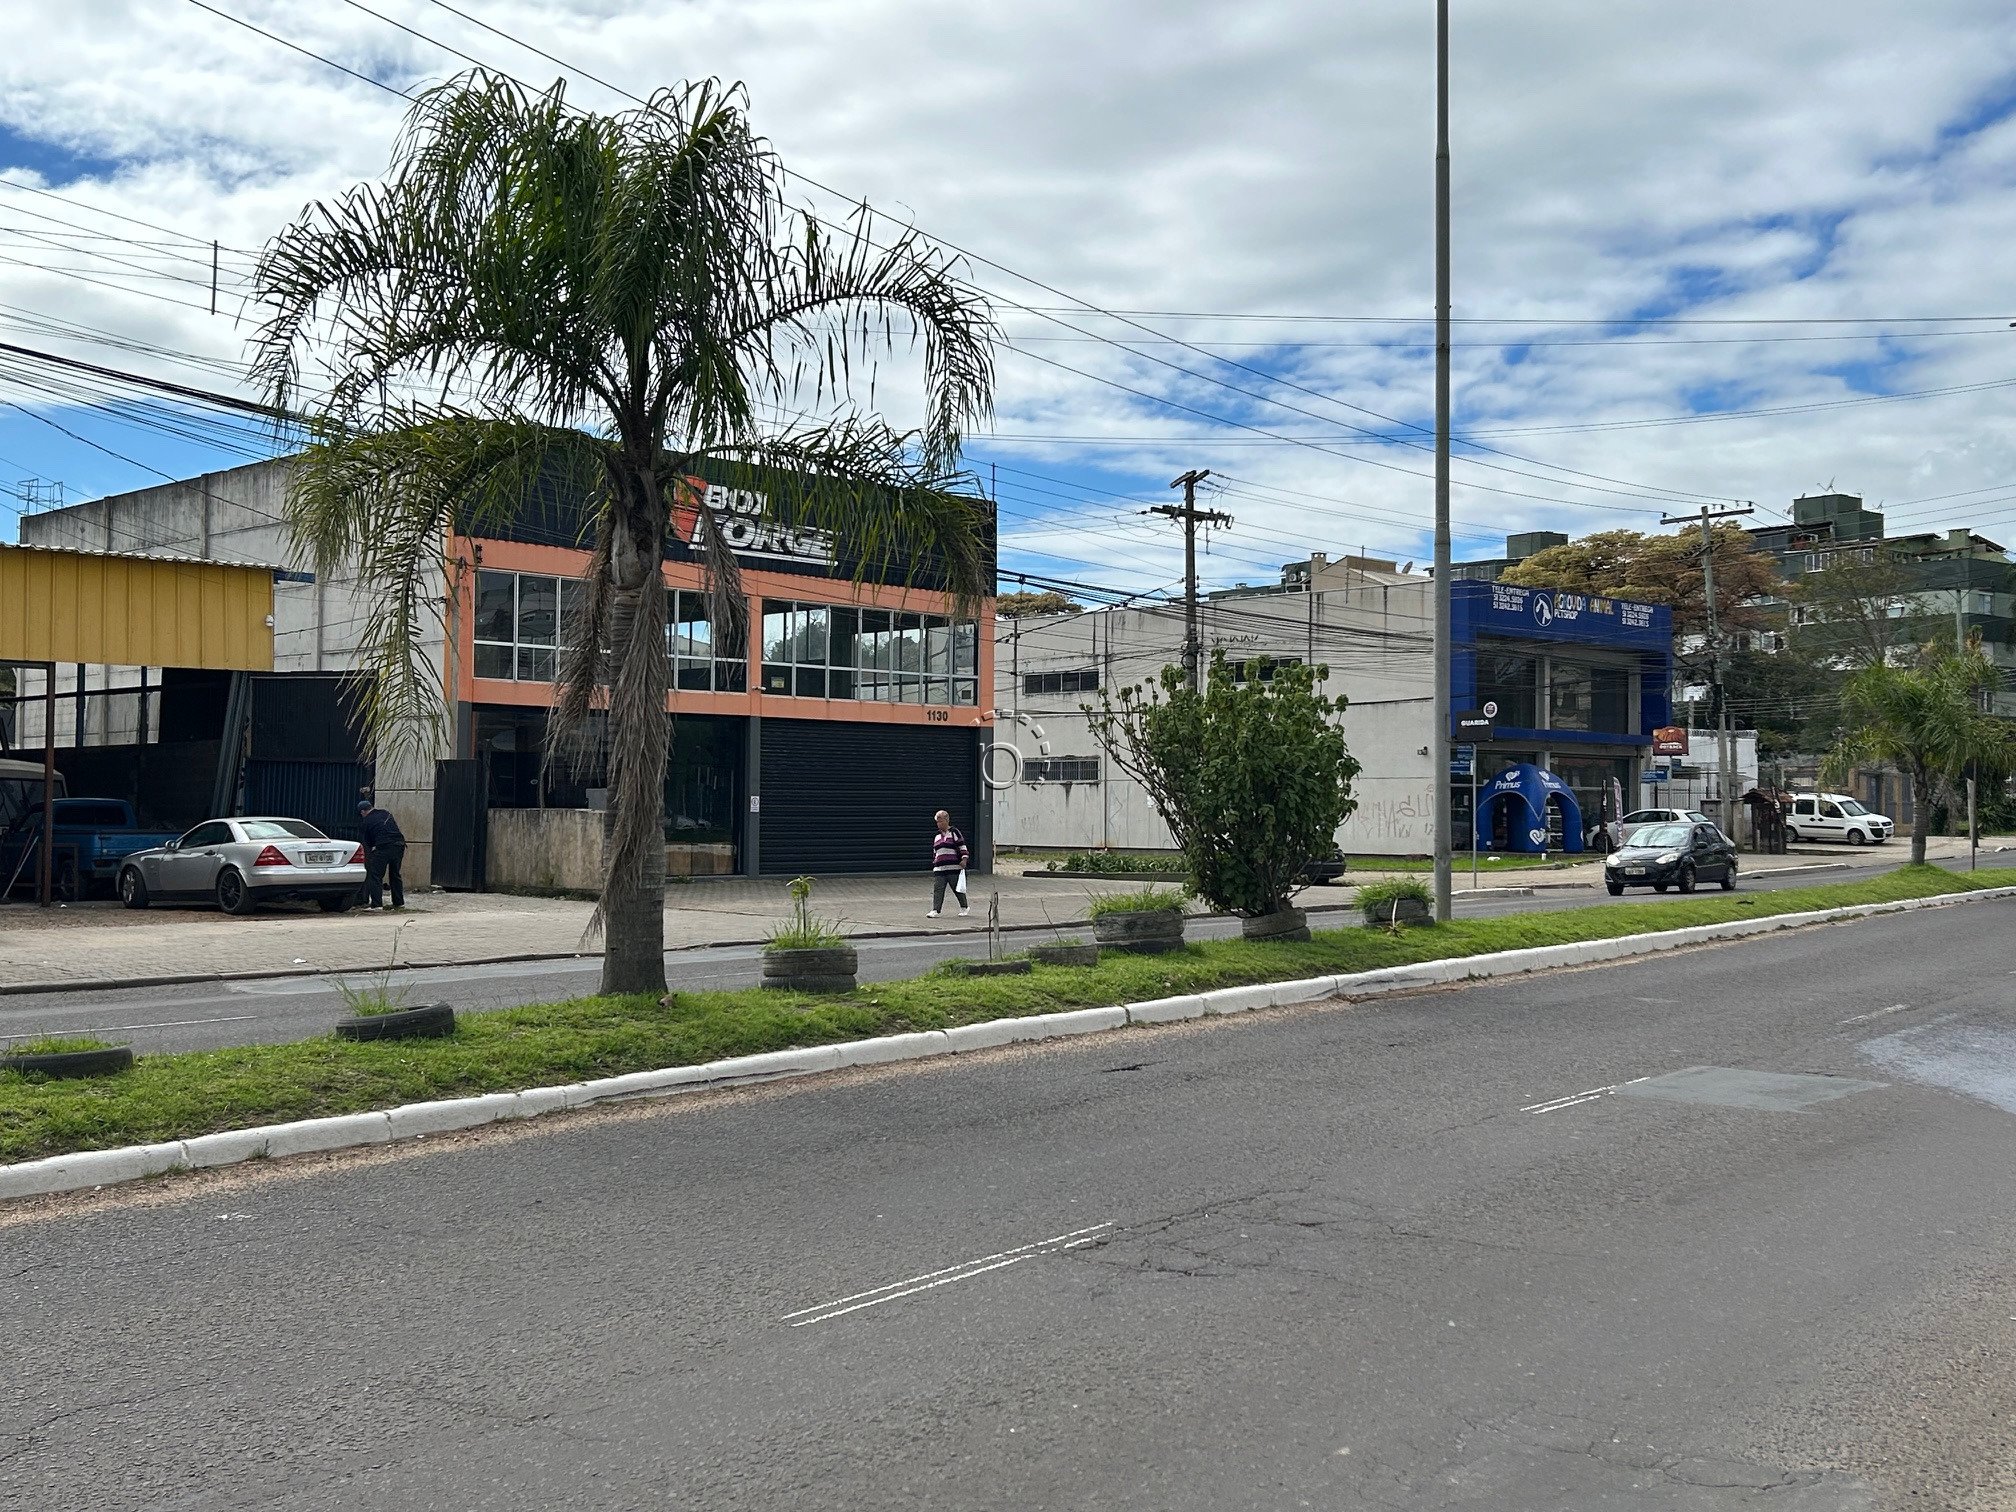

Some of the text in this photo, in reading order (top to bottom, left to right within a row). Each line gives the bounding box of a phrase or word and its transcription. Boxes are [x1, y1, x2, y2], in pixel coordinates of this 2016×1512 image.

[926, 710, 949, 722] 1130
[1461, 719, 1490, 727] GUARIDA
[1494, 780, 1522, 790] Primus
